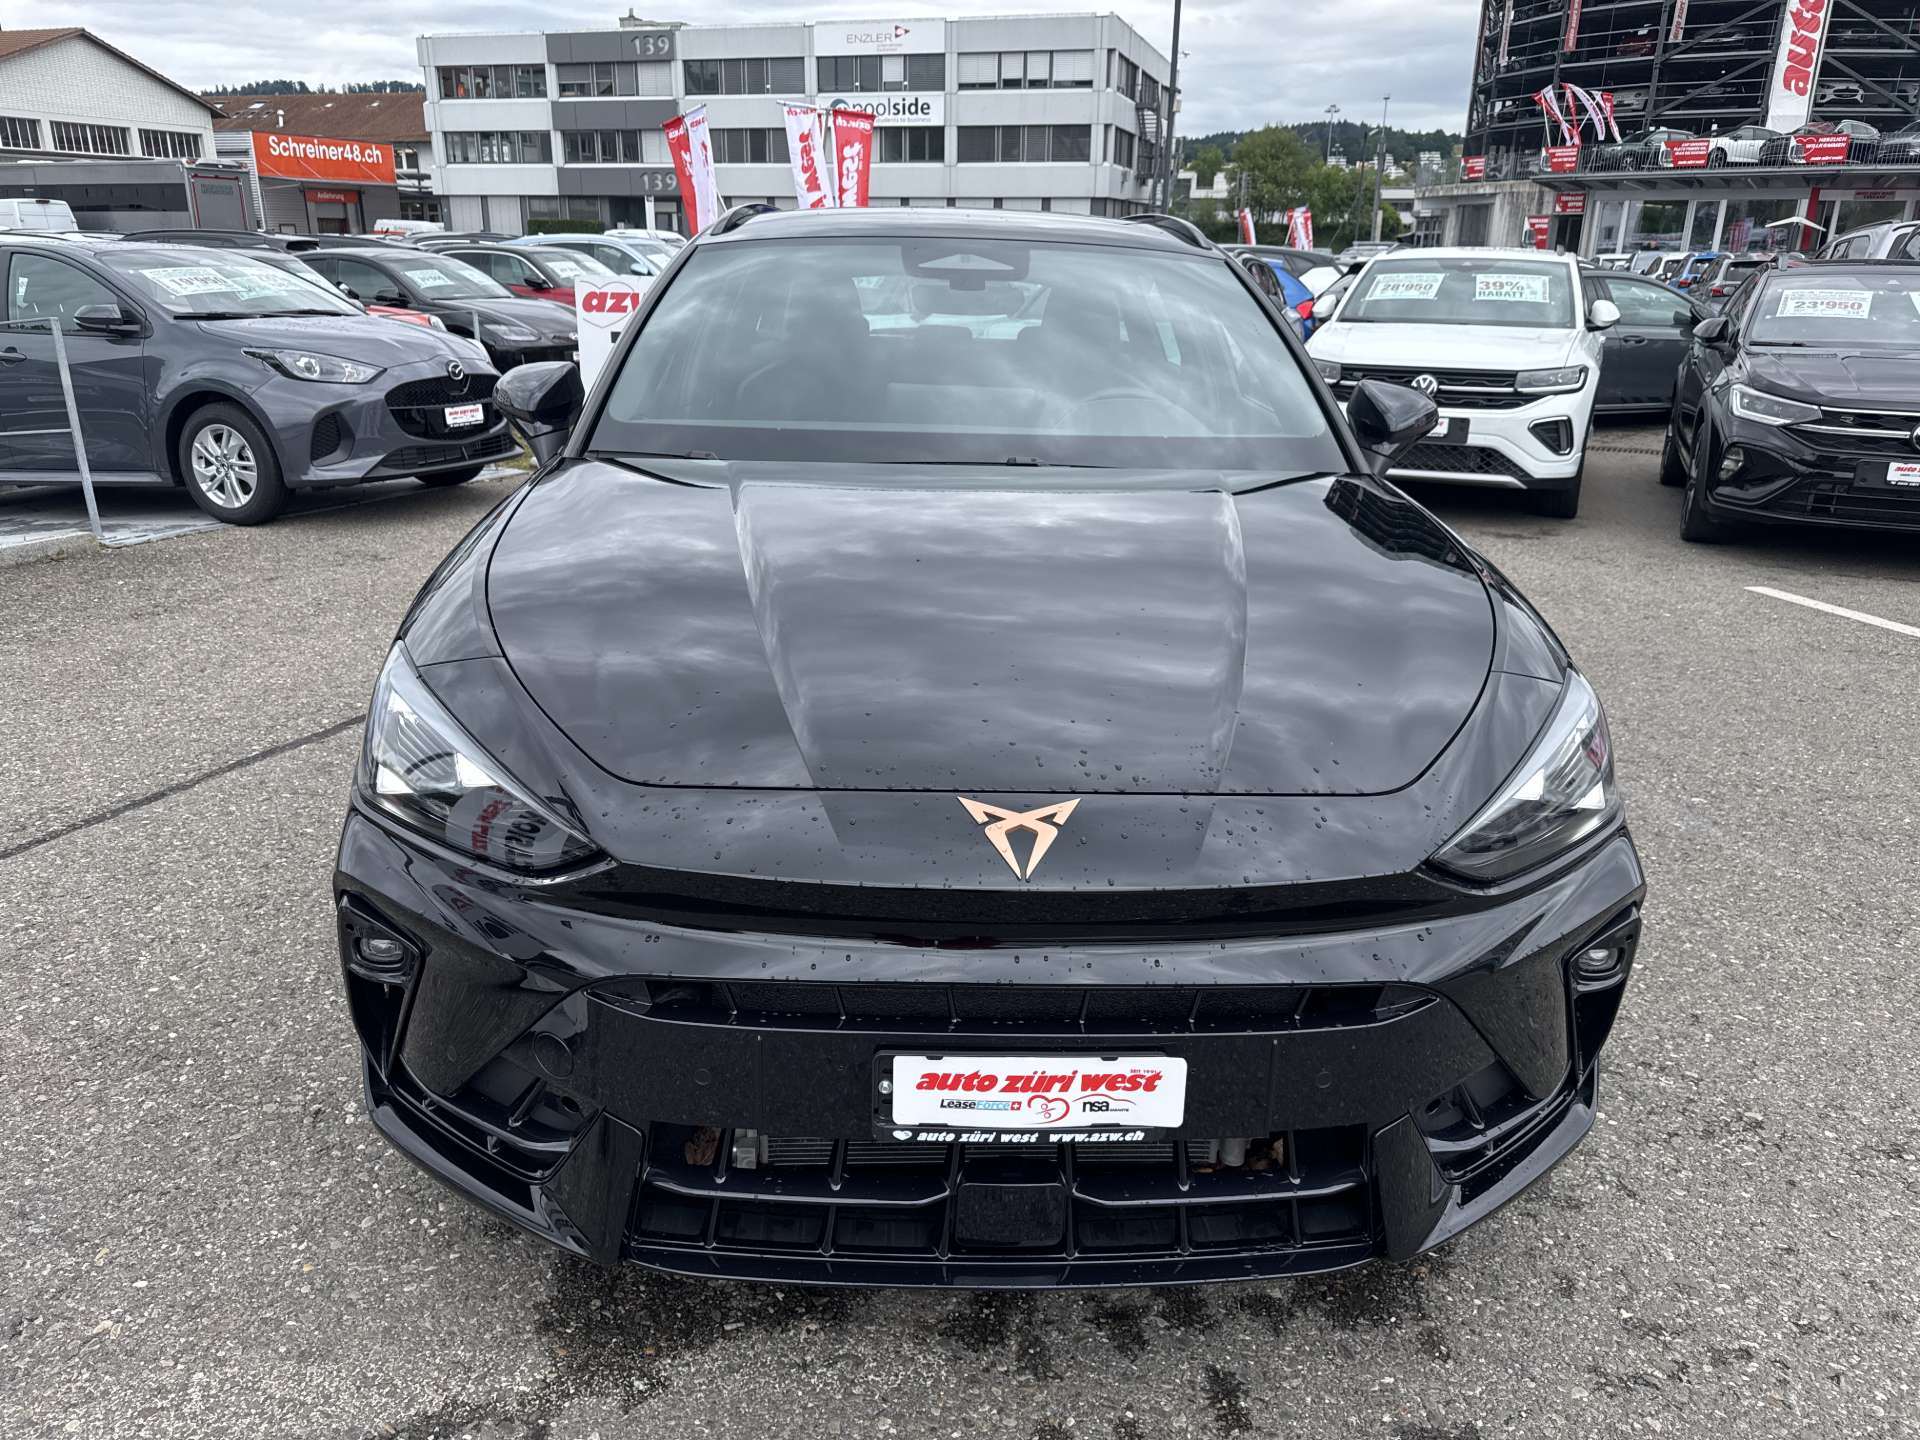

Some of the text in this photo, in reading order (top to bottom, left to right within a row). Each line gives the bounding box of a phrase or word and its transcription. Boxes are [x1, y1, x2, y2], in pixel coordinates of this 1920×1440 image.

[631, 34, 670, 55] 139
[846, 32, 893, 44] ENZLER
[268, 135, 382, 164] Schreiner48.ch
[640, 172, 677, 191] 139
[1479, 280, 1525, 292] 39%
[1794, 300, 1863, 310] 23'950
[916, 1069, 1163, 1093] auto züri west
[940, 1098, 1010, 1111] LeaseForce
[1082, 1101, 1110, 1112] nsa
[917, 1130, 1145, 1143] auto züri west www.azw.ch
